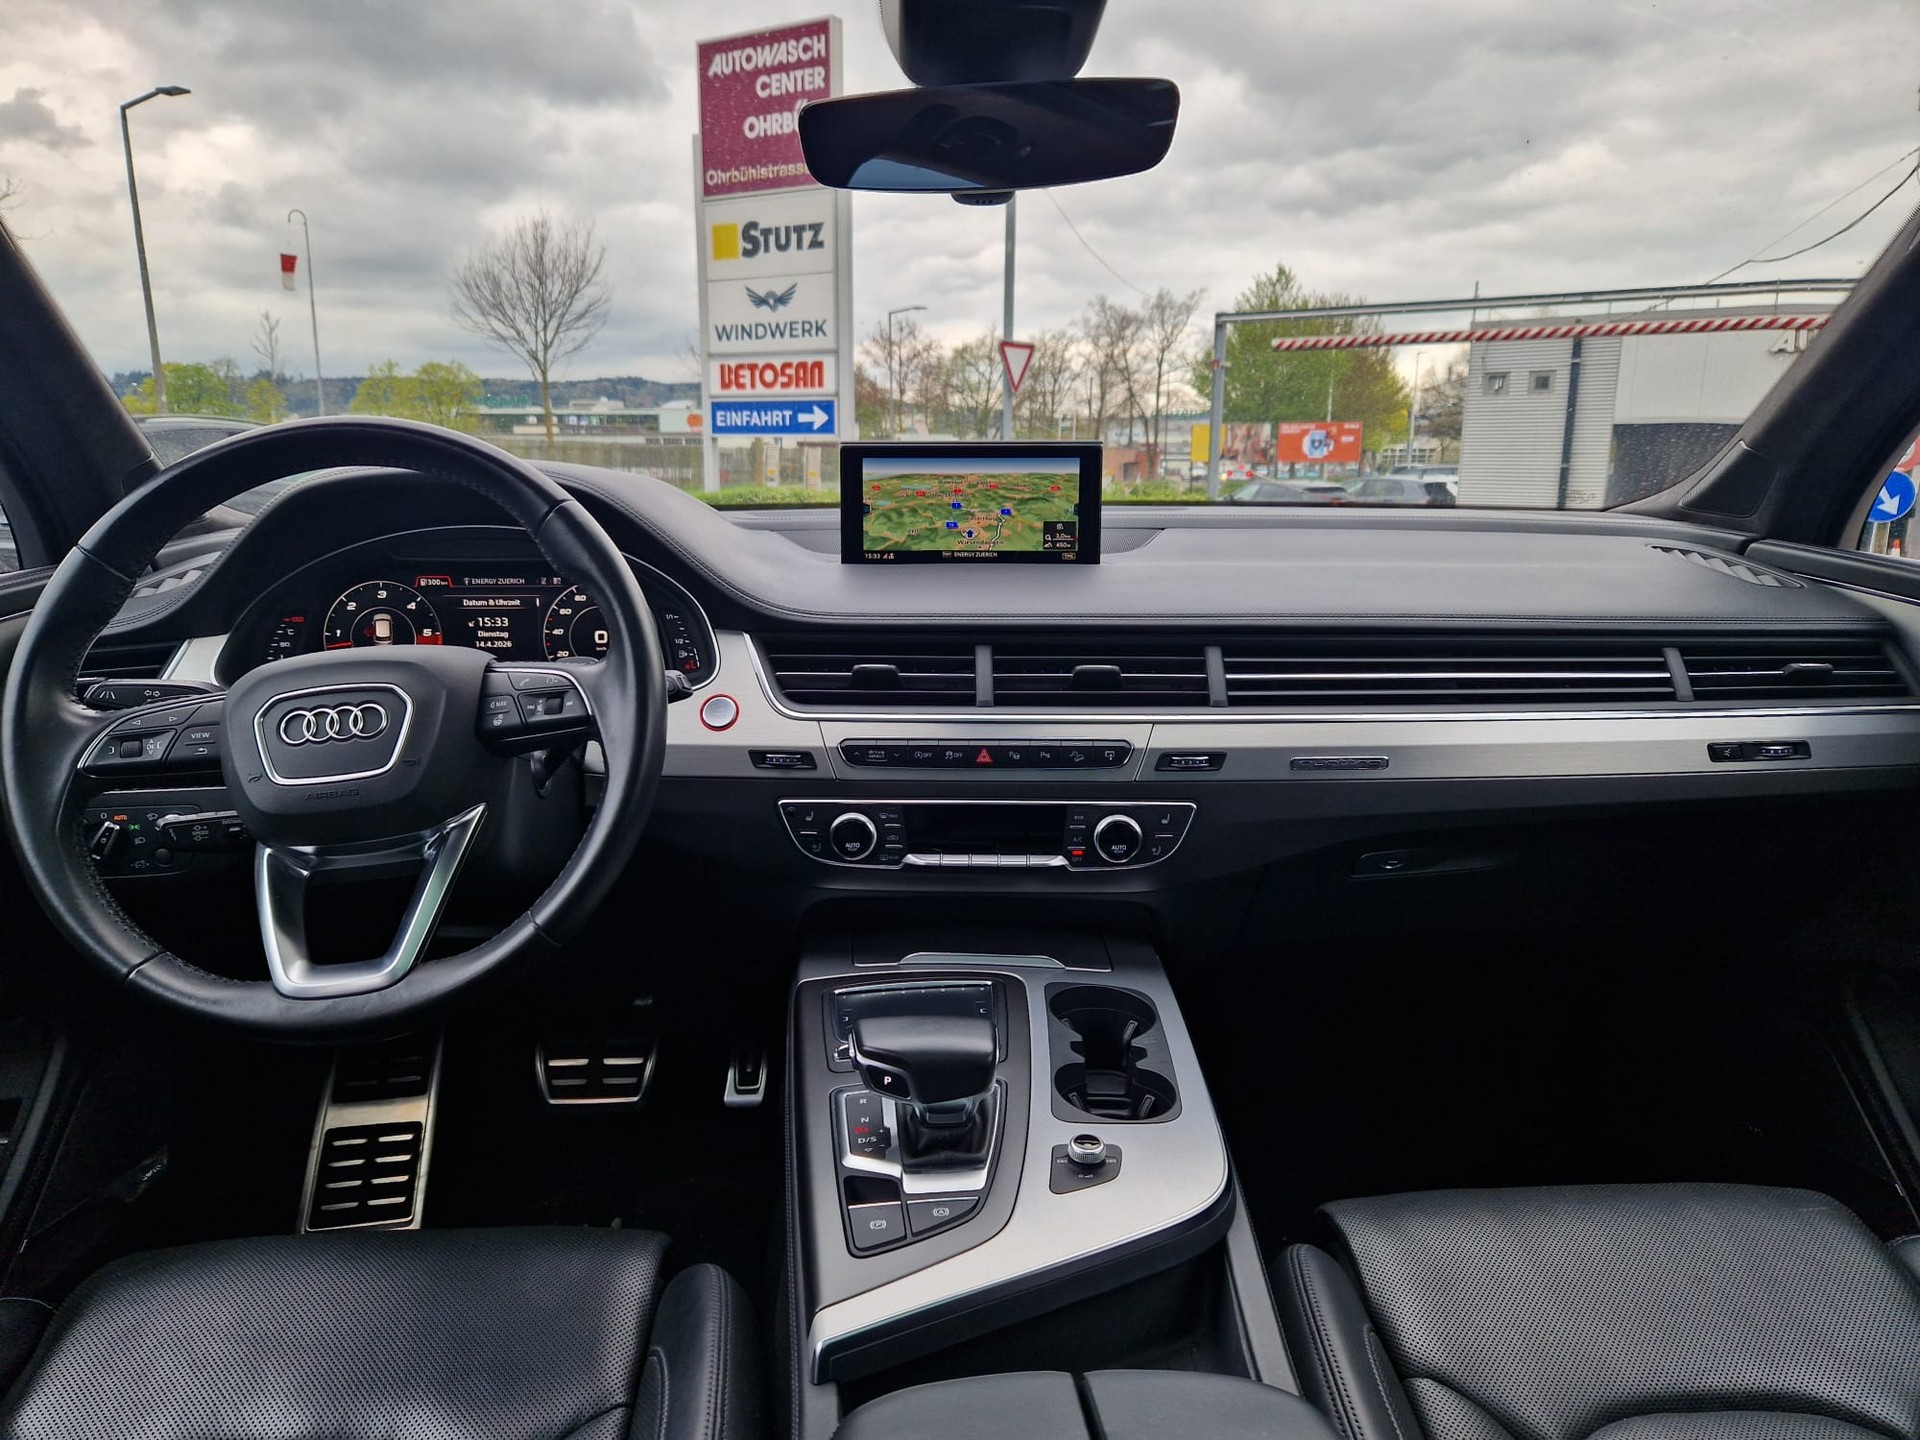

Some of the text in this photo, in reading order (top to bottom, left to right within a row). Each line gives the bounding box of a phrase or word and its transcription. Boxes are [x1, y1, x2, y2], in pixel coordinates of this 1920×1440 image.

[708, 34, 826, 77] AUTOWASCH
[755, 66, 825, 99] CENTER
[714, 319, 827, 342] WINDWERK
[716, 410, 793, 428] EINFAHRT
[377, 590, 387, 599] 3
[574, 594, 587, 602] 80
[346, 602, 357, 611] 2
[406, 602, 416, 610] 4
[463, 599, 486, 607] Datum
[477, 617, 509, 627] 15:33
[335, 629, 341, 637] 1
[422, 628, 432, 636] 5
[477, 630, 509, 639] Dienstag
[594, 630, 609, 644] 0
[556, 650, 569, 658] 20
[190, 731, 211, 739] VIEW
[305, 788, 360, 801] AIRBAG
[884, 1076, 892, 1086] P
[857, 1136, 877, 1144] D/S
